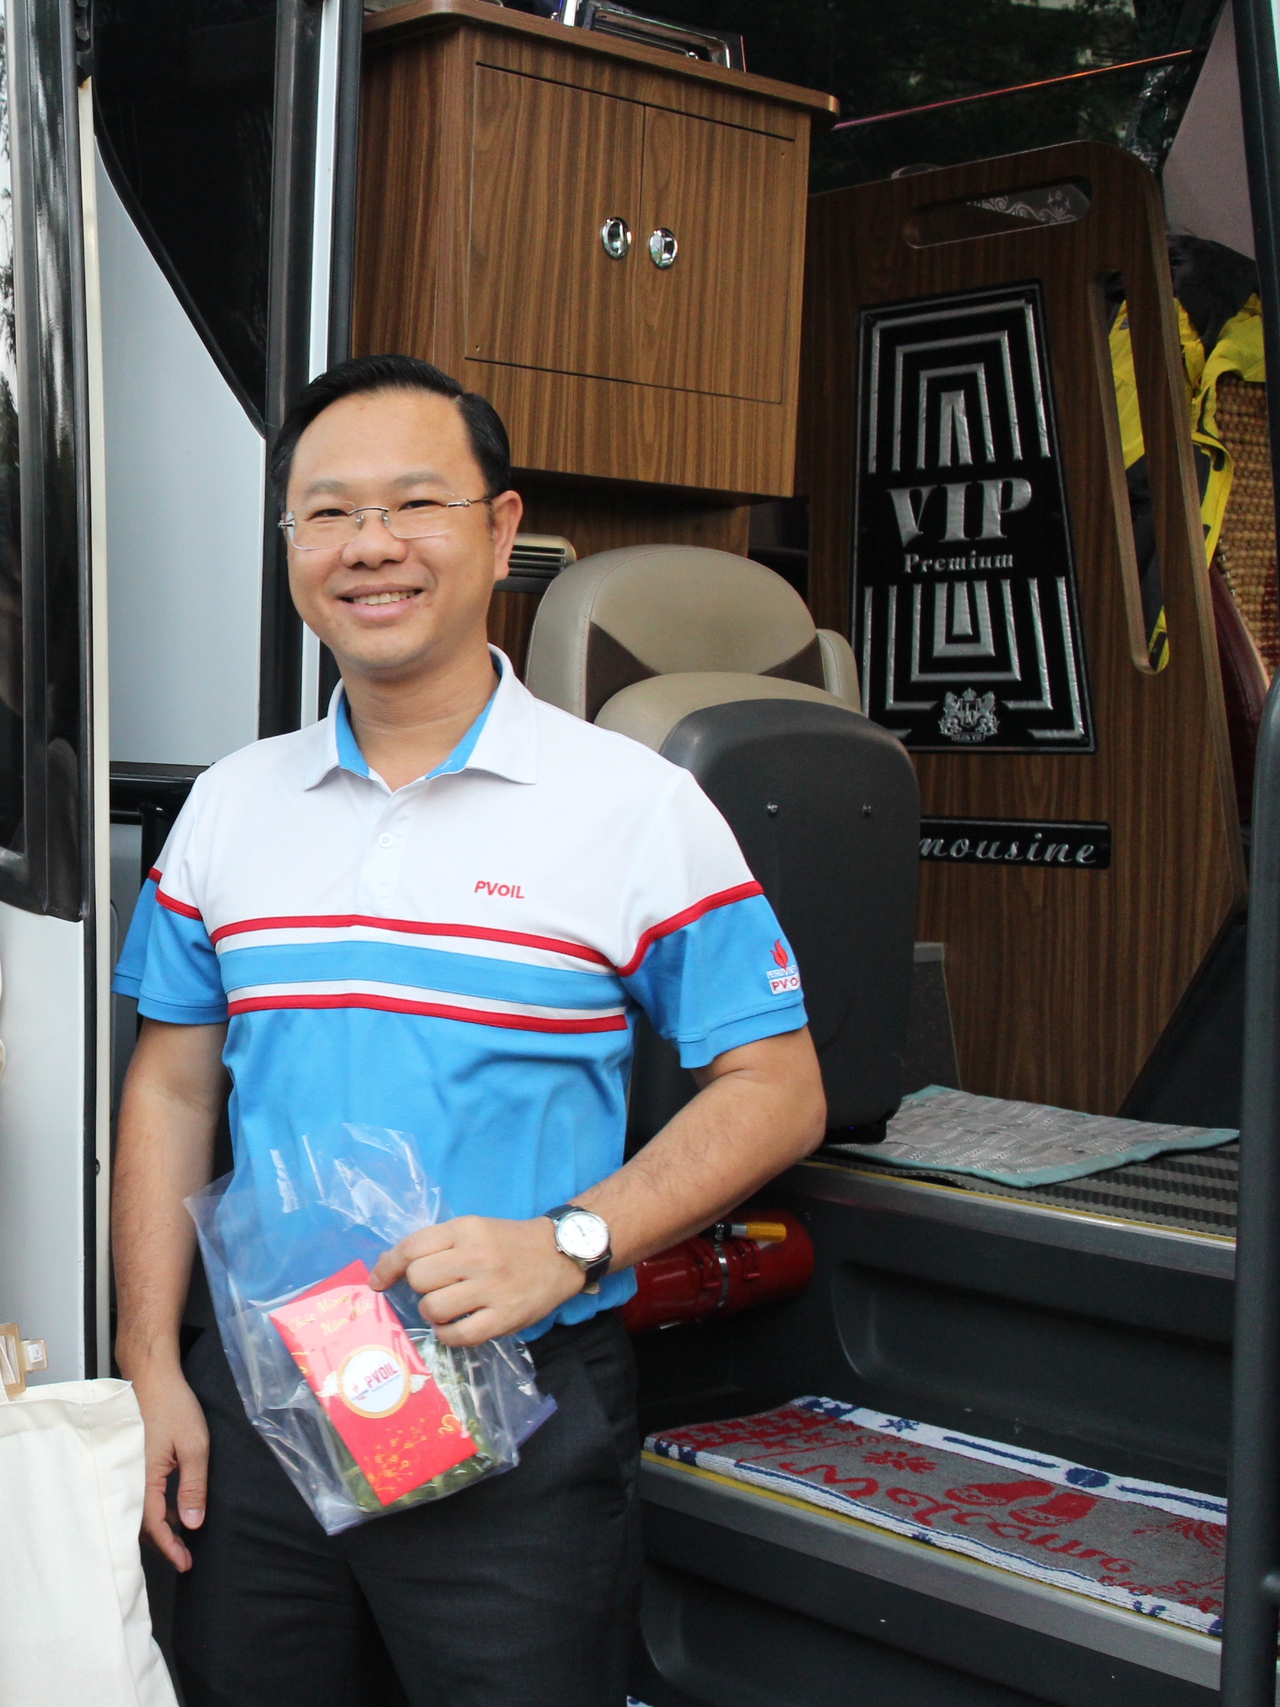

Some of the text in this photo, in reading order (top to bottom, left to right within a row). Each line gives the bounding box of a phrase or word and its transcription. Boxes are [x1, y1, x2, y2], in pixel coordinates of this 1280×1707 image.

[887, 477, 1032, 549] VIP
[904, 550, 1014, 574] Premium
[474, 880, 525, 899] PVOIL
[365, 1362, 399, 1389] PVOIL
